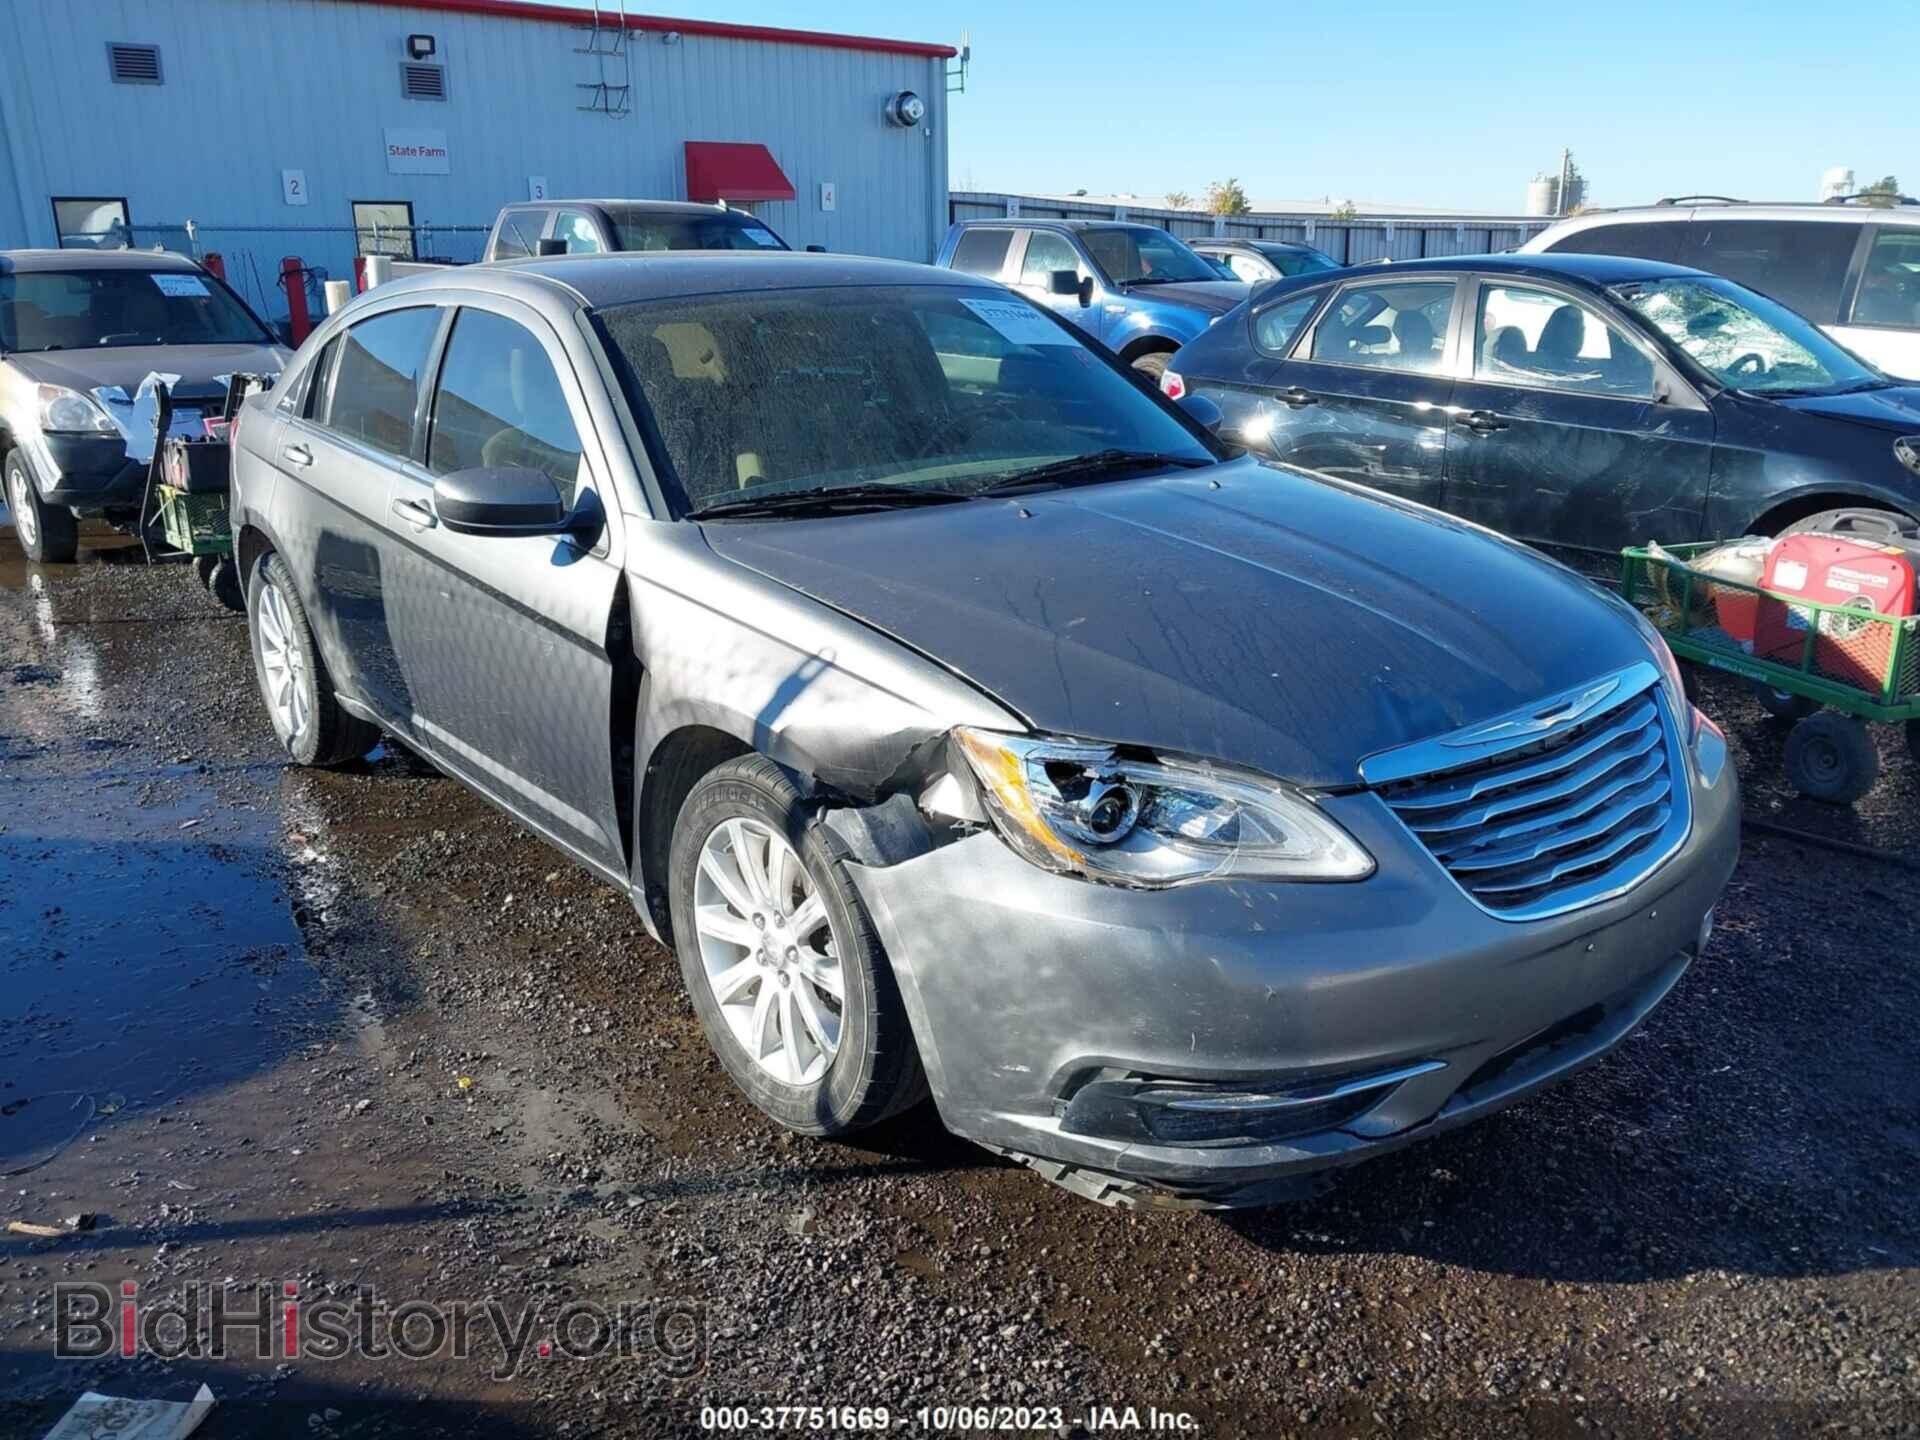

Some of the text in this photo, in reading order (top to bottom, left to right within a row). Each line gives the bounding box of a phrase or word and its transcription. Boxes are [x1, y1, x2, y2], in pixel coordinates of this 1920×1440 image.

[389, 145, 446, 157] State Farm
[290, 179, 300, 195] 2
[535, 185, 543, 199] 3
[825, 191, 831, 203] 4
